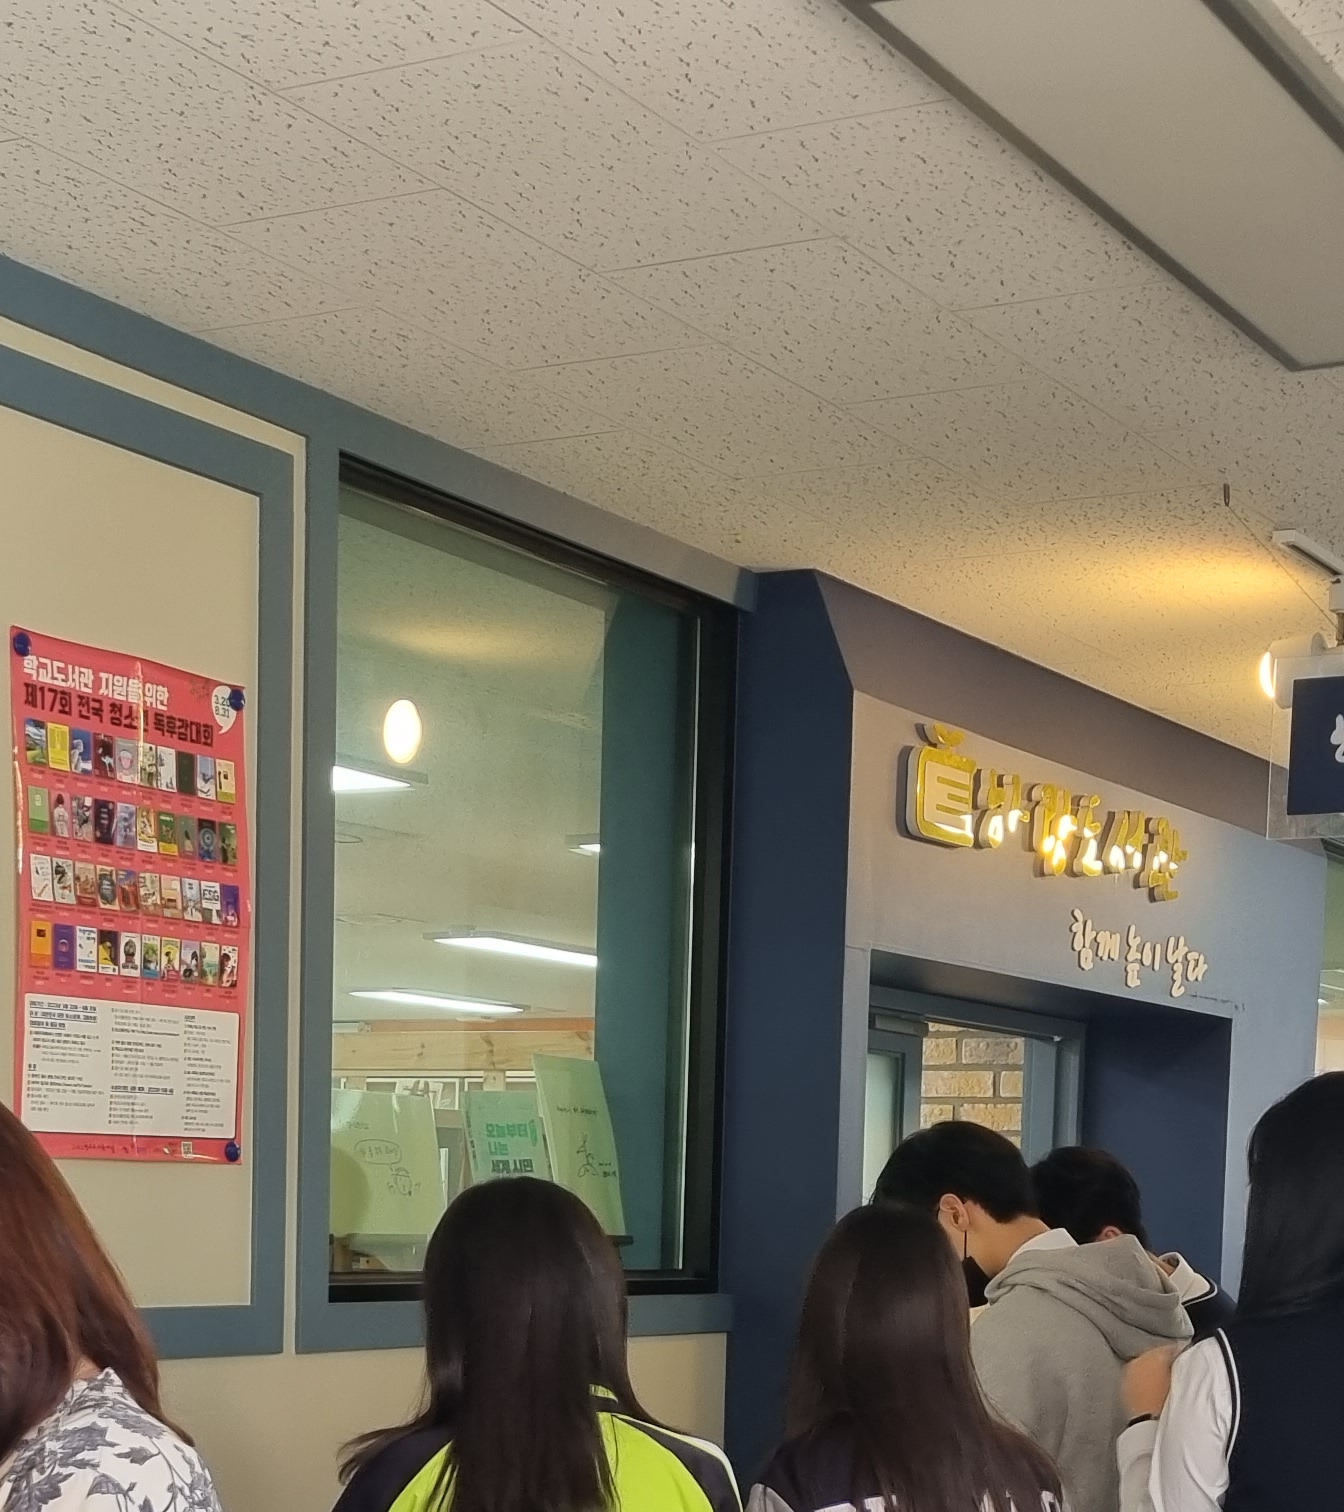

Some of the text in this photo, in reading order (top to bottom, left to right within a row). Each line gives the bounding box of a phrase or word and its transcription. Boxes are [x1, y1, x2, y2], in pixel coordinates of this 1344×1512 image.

[23, 655, 94, 693] 학교도서관
[144, 683, 169, 710] 위한
[24, 682, 72, 716] 제17회
[77, 694, 104, 723] 전국
[153, 712, 214, 748] 독후감대회
[1071, 908, 1208, 998] 함께 높이 날다
